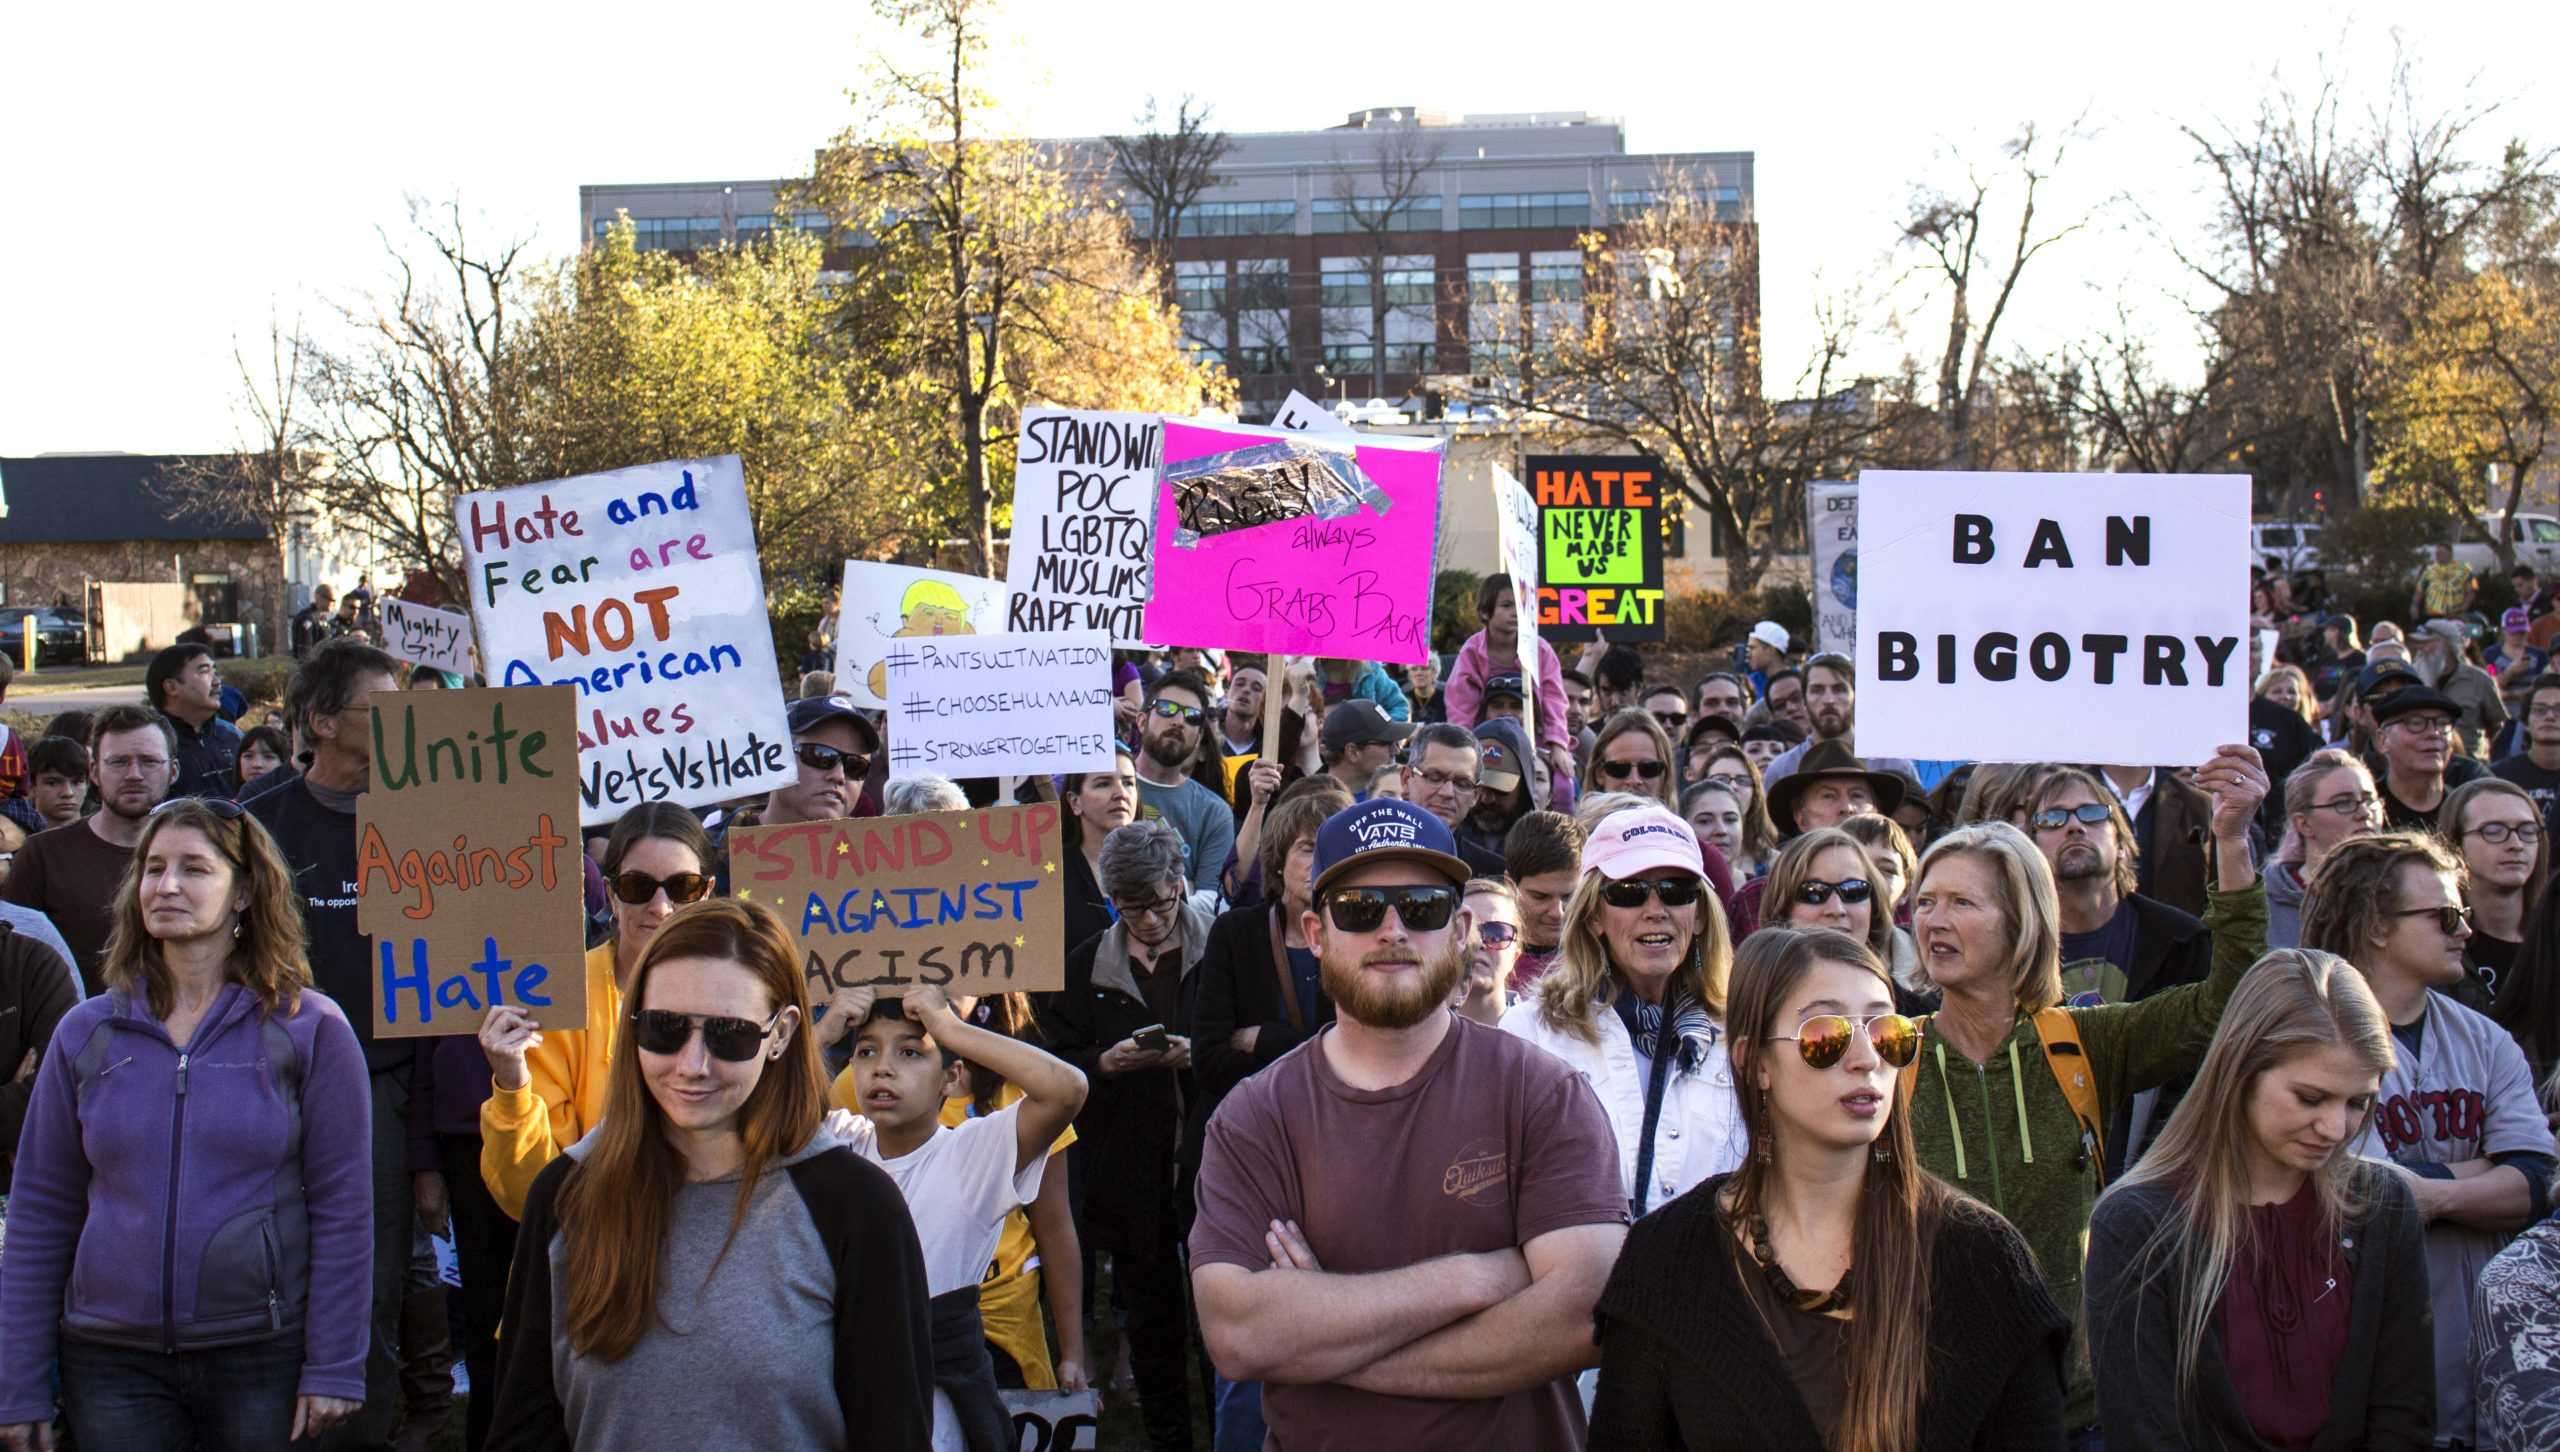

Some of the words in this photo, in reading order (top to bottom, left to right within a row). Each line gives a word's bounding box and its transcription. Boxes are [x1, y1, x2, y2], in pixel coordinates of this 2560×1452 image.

[471, 495, 583, 552] Hate
[607, 470, 699, 525] and
[1057, 470, 1136, 515] POC
[1536, 471, 1653, 507] HATE
[1042, 514, 1148, 562] LGBTQ
[1292, 519, 1376, 566] always
[1553, 510, 1632, 540] NEVER
[1953, 513, 2151, 569] BAN
[484, 556, 599, 607] Fear
[629, 533, 713, 572] are
[1566, 541, 1628, 558] MADE
[1577, 557, 1608, 578] US
[1031, 554, 1147, 602] MUSLIMS
[388, 605, 459, 652] Mighty
[543, 586, 680, 661] NOT
[1226, 558, 1336, 638] GRABS
[1338, 570, 1424, 657] BACK
[1536, 587, 1664, 625] GREAT
[402, 637, 457, 667] Girl
[504, 644, 741, 696] American
[1878, 631, 2239, 687] BIGOTRY
[371, 701, 554, 791] Unite
[755, 819, 953, 881] STAND
[977, 804, 1058, 866] UP
[1357, 823, 1415, 842] VANS
[1371, 808, 1393, 818] THE
[1396, 809, 1424, 829] WALL
[357, 813, 567, 920] Against
[801, 880, 1039, 937] AGAINST
[380, 936, 552, 1023] Hate
